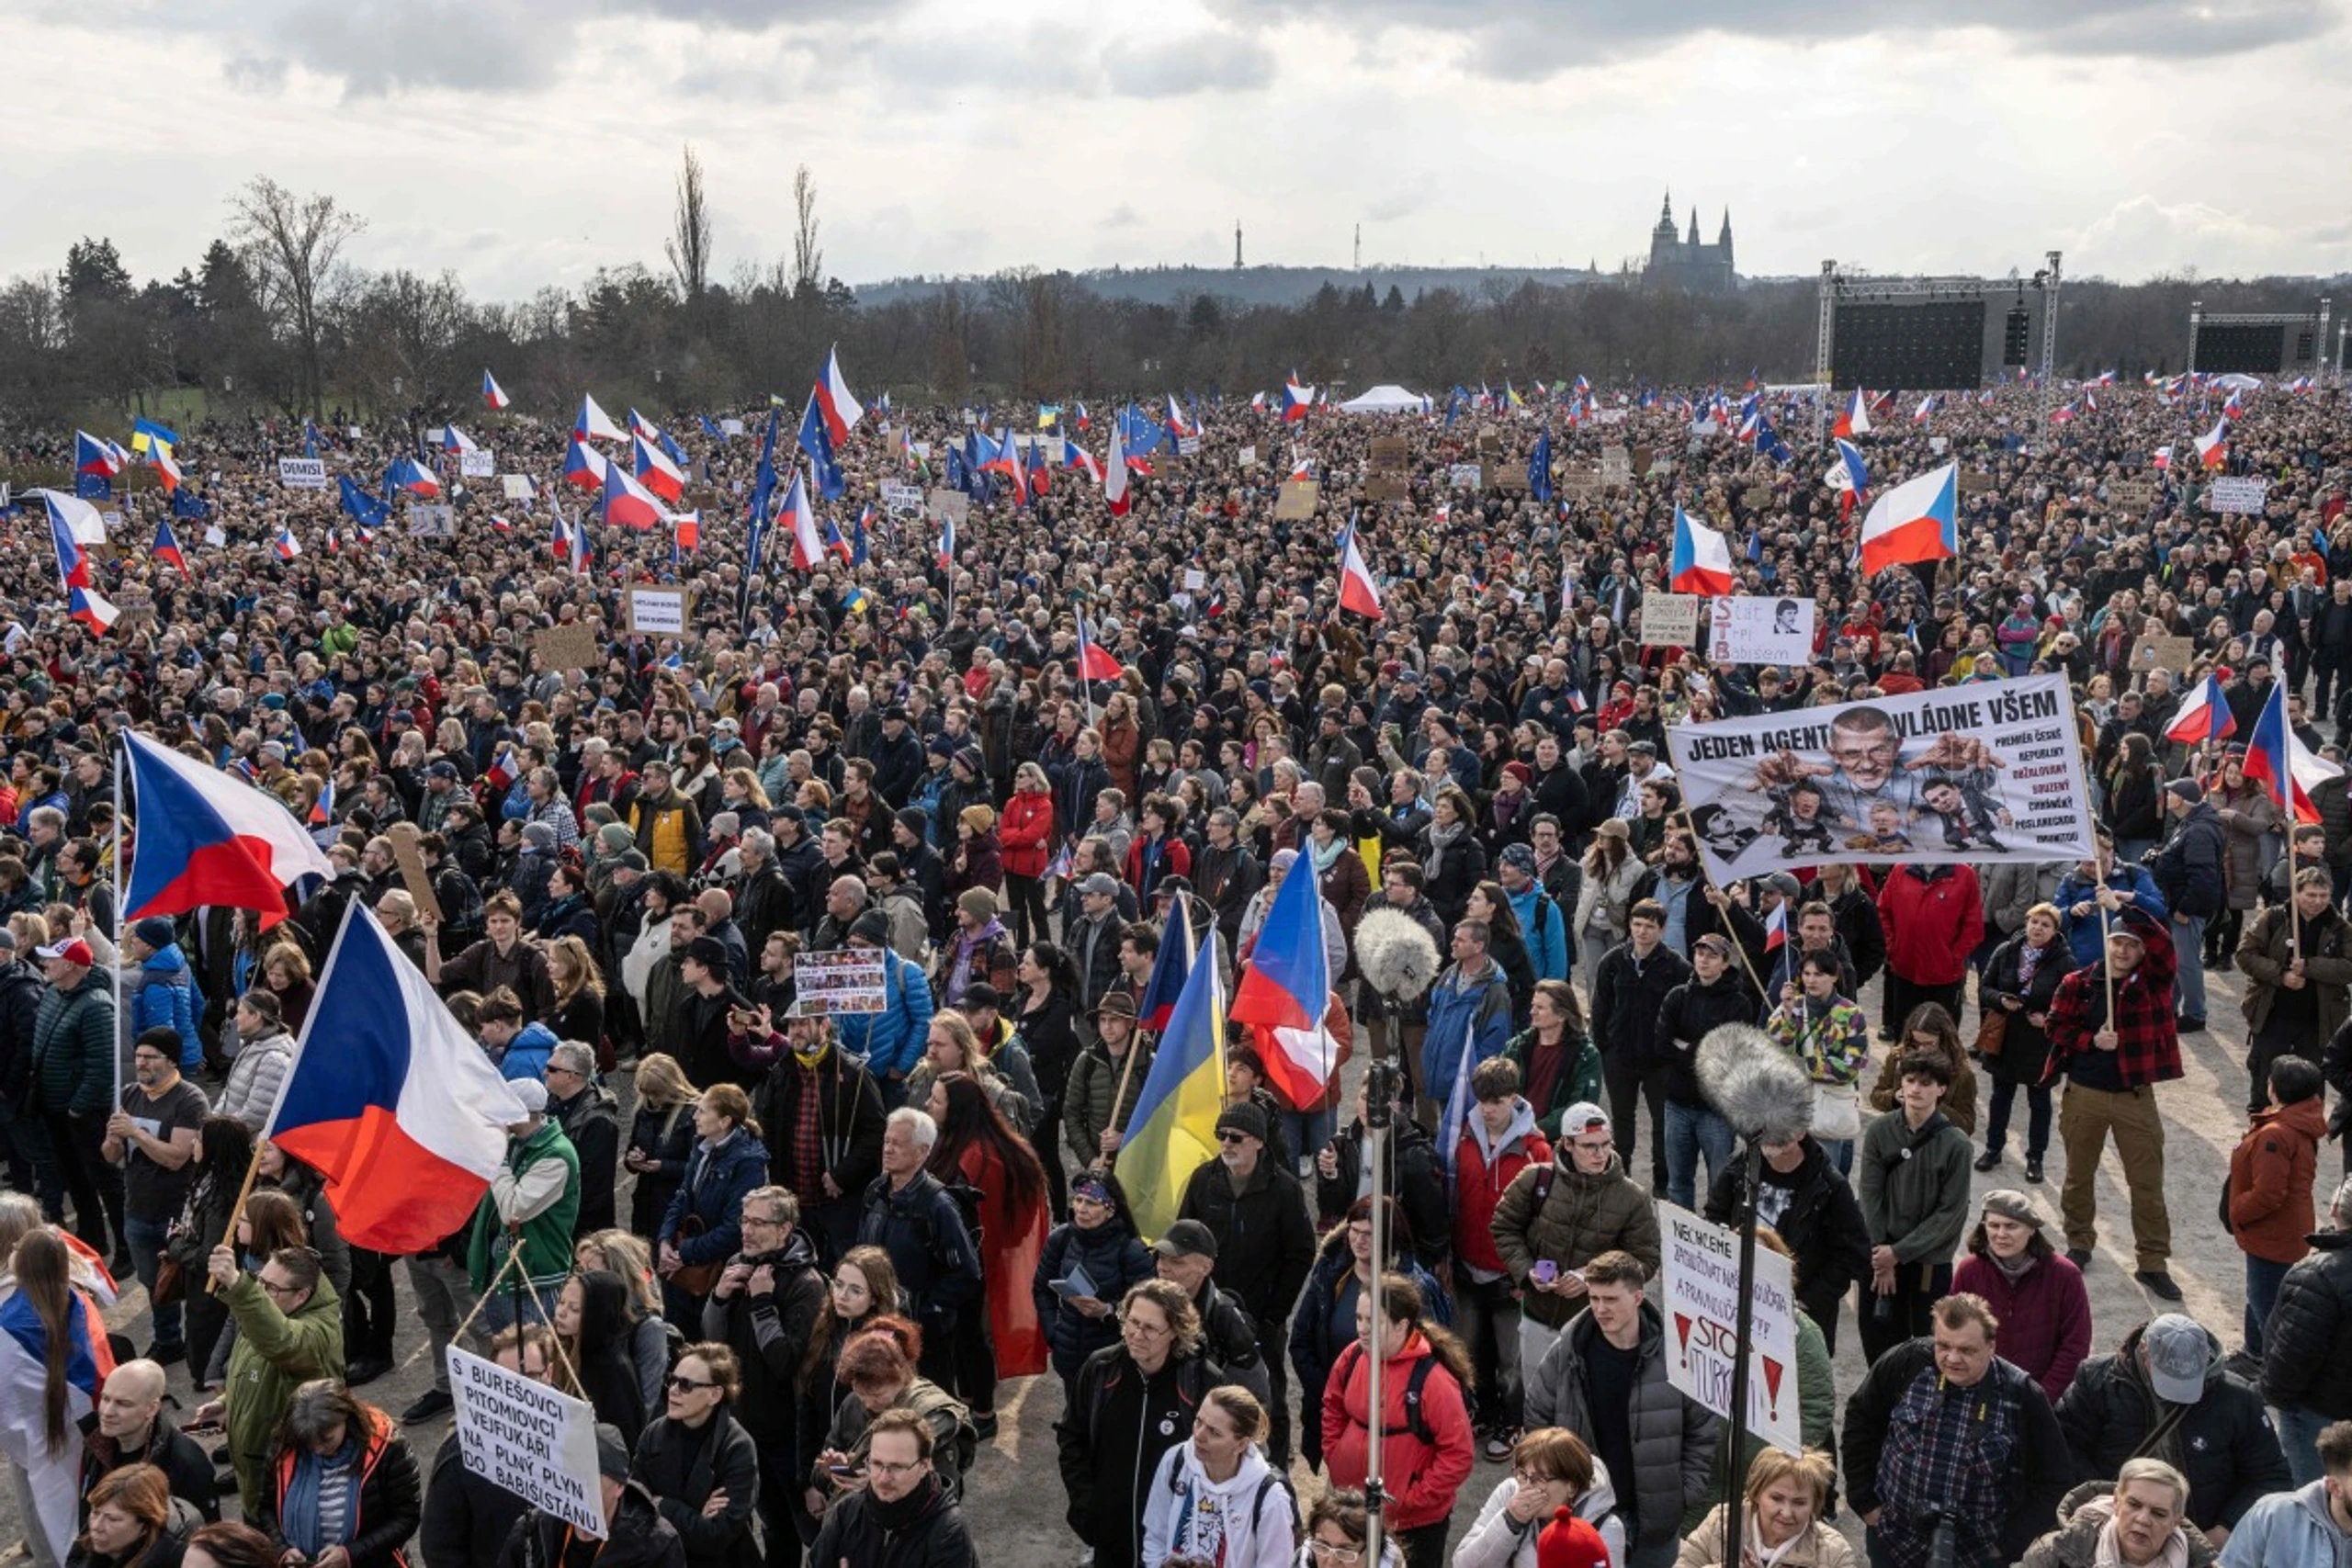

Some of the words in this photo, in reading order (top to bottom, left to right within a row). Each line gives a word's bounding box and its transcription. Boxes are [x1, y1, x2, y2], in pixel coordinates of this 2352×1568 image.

[1688, 734, 1756, 761] JEDEN
[1761, 724, 1829, 753] AGENT
[1893, 701, 1983, 738] VLÁDNE
[1987, 689, 2059, 725] VŠEM
[1692, 1314, 1755, 1360] STO
[452, 1358, 463, 1376] S
[471, 1365, 564, 1422] BUREŠOVCI
[464, 1385, 556, 1440] PITOMIOVCI
[462, 1427, 486, 1451] NA
[494, 1444, 534, 1477] PLNÝ
[542, 1468, 584, 1502] PLYN
[469, 1408, 550, 1461] VEJFUKÁŘI
[462, 1450, 486, 1473] DO
[494, 1466, 597, 1531] BABIŠISTÁNU
